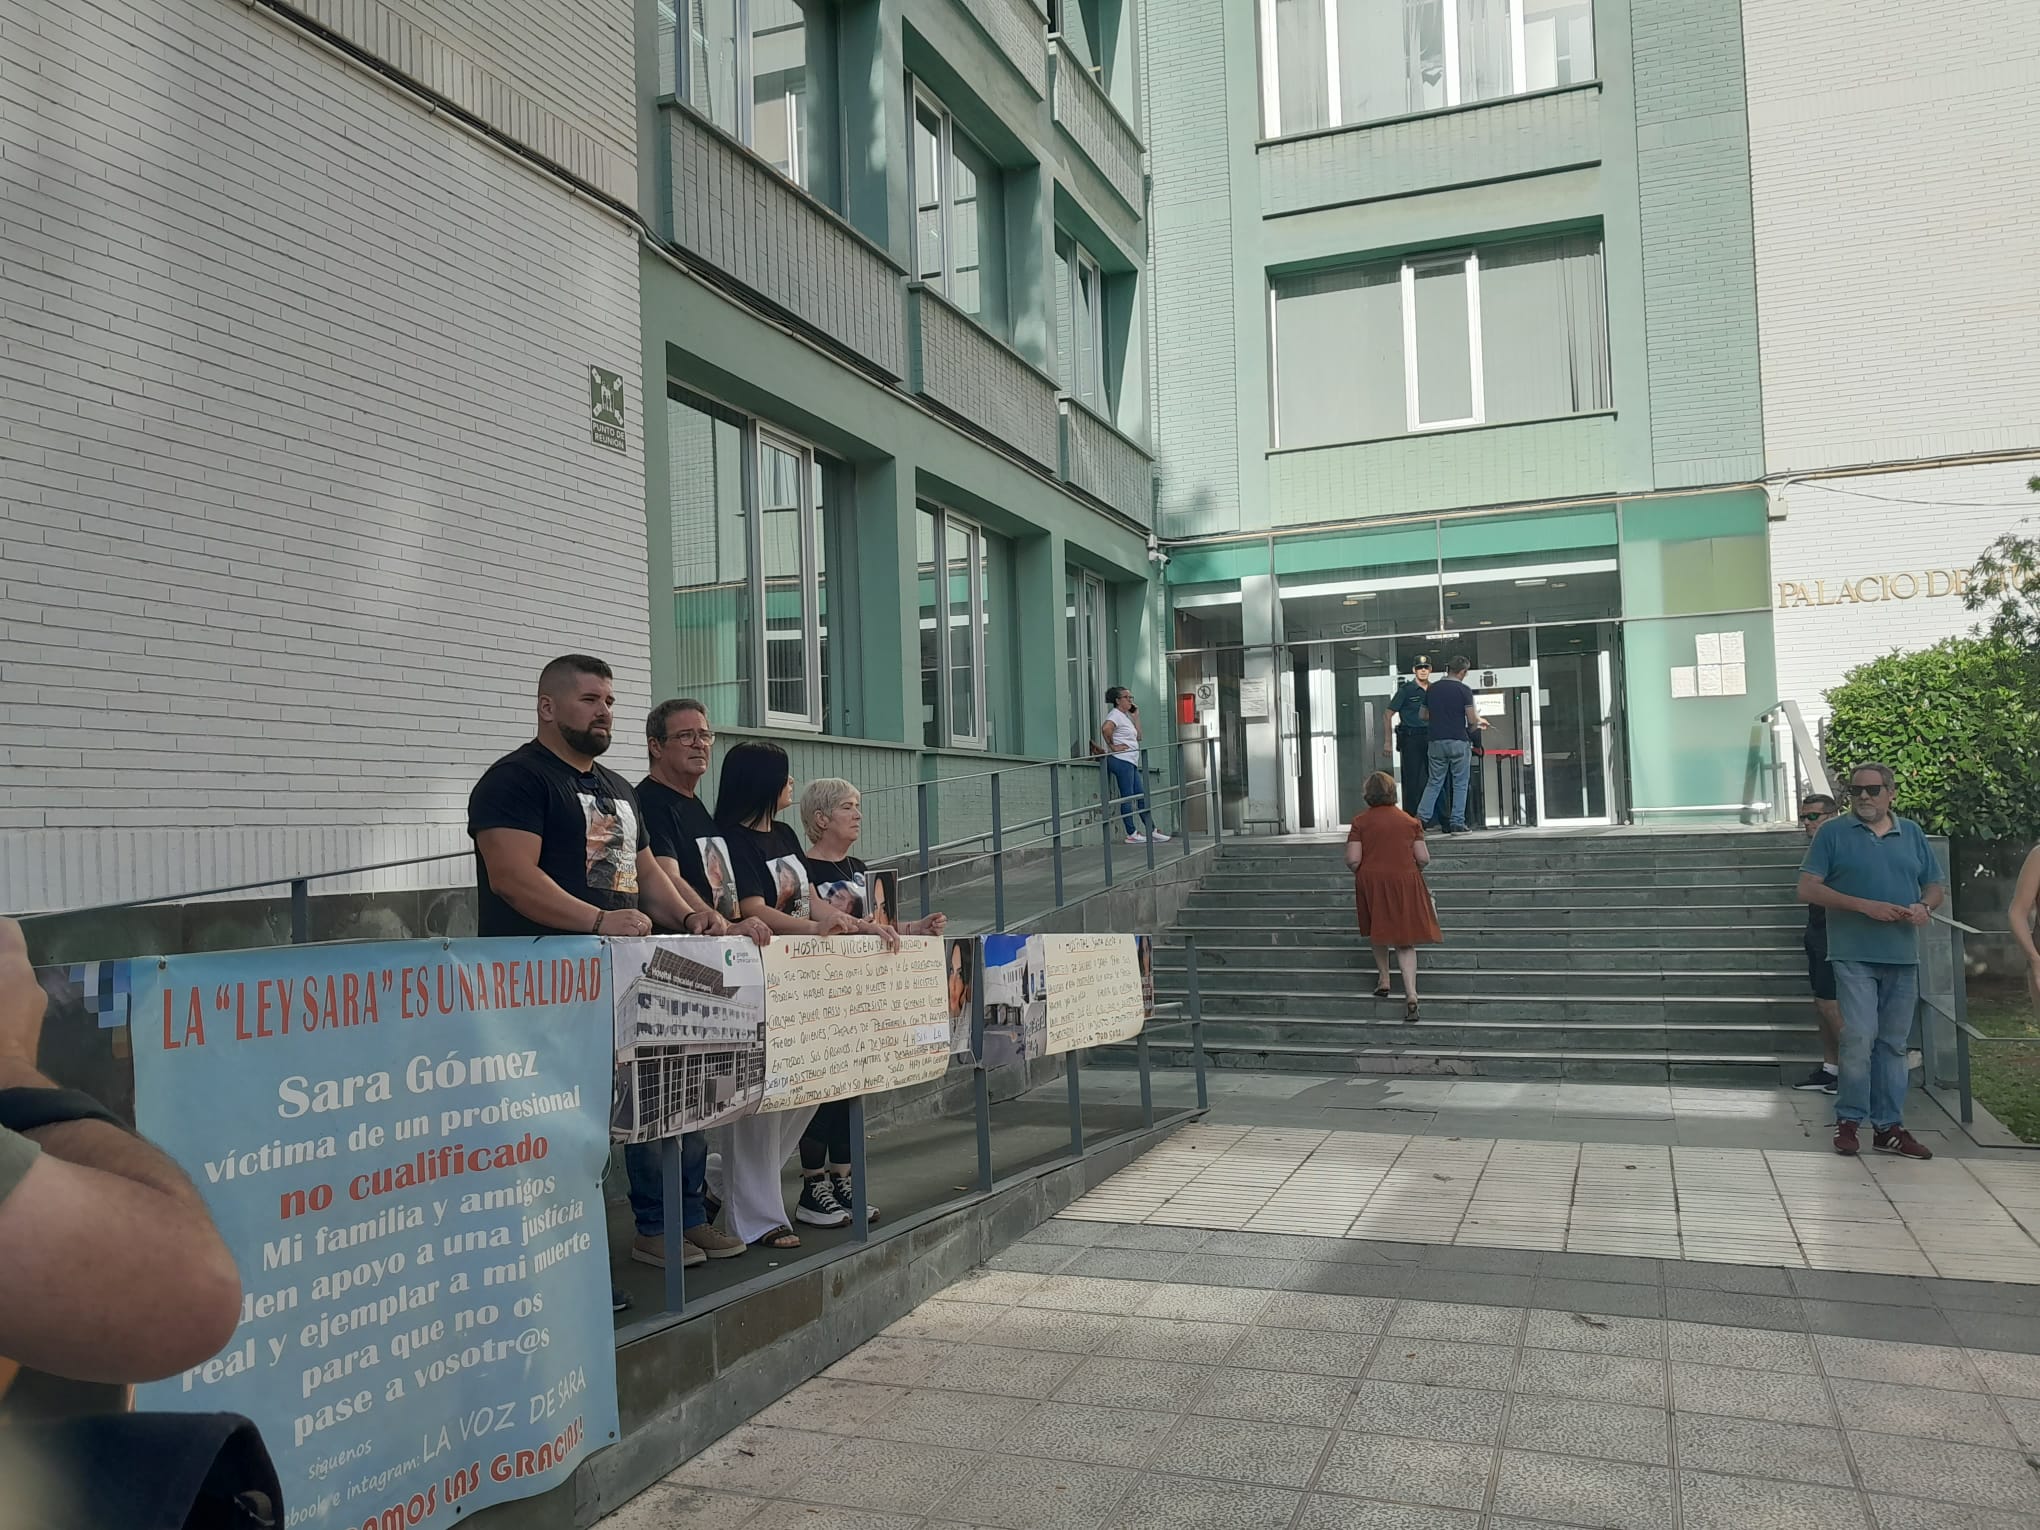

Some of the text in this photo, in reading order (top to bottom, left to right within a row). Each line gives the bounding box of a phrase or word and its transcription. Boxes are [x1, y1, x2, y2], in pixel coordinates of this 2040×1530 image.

[592, 422, 625, 440] PUNTO DE
[1777, 573, 1920, 609] PALACIO
[1924, 568, 1974, 597] DE
[792, 938, 836, 957] HOSPITAL
[841, 939, 874, 955] VIRGEN
[797, 970, 820, 980] DONDE
[162, 986, 205, 1050] LA
[401, 965, 429, 1019] ES
[437, 961, 488, 1015] UNA
[491, 957, 601, 1012] REALIDAD
[803, 987, 824, 999] HABER
[860, 1022, 869, 1032] DE
[278, 1050, 539, 1118] Sara Gómez
[856, 1038, 865, 1052] LA
[204, 1085, 581, 1185] víctima de un profesional
[279, 1132, 548, 1220] no cualificado
[263, 1175, 556, 1272] Mi familia y amigos
[312, 1252, 405, 1300] apoyo
[416, 1244, 435, 1265] a
[443, 1226, 512, 1256] una
[521, 1199, 584, 1246] justicia
[268, 1333, 287, 1367] y
[300, 1280, 440, 1348] ejemplar
[449, 1272, 471, 1294] a
[483, 1254, 527, 1286] mi
[534, 1231, 591, 1273] muerte
[294, 1327, 550, 1447] pase a vosotr@s
[302, 1292, 543, 1399] para que no os
[332, 1491, 341, 1506] e
[346, 1455, 420, 1501] intagram:
[423, 1425, 451, 1464] LA
[459, 1402, 517, 1441] VOZ
[529, 1392, 556, 1424] DE
[555, 1365, 587, 1409] SARA
[444, 1460, 481, 1504] LAS
[489, 1414, 584, 1483] GRACIAS!
